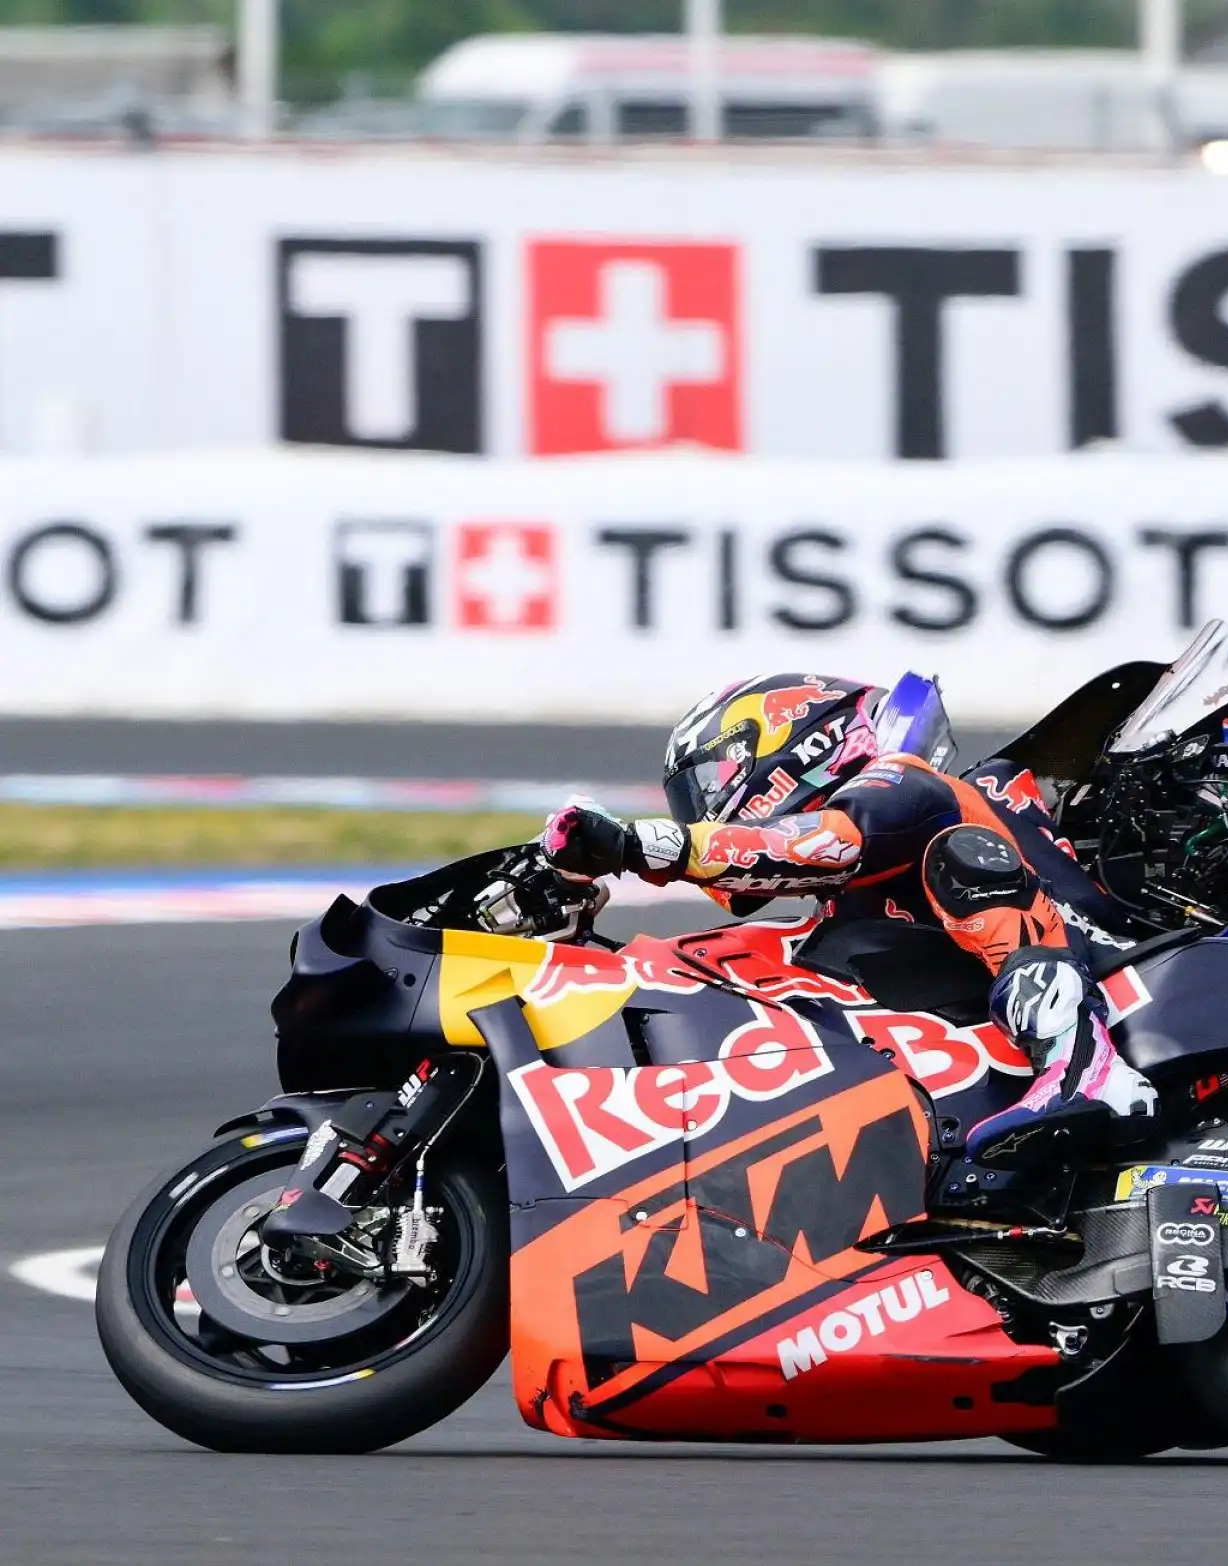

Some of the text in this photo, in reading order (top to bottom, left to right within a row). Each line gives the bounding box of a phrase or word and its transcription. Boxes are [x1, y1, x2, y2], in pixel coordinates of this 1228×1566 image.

[790, 713, 847, 767] KYT
[398, 1058, 431, 1107] WP
[508, 1000, 834, 1192] Red
[573, 1105, 926, 1388] KTM
[1156, 1275, 1216, 1293] RCB
[775, 1271, 950, 1380] MOTUL
